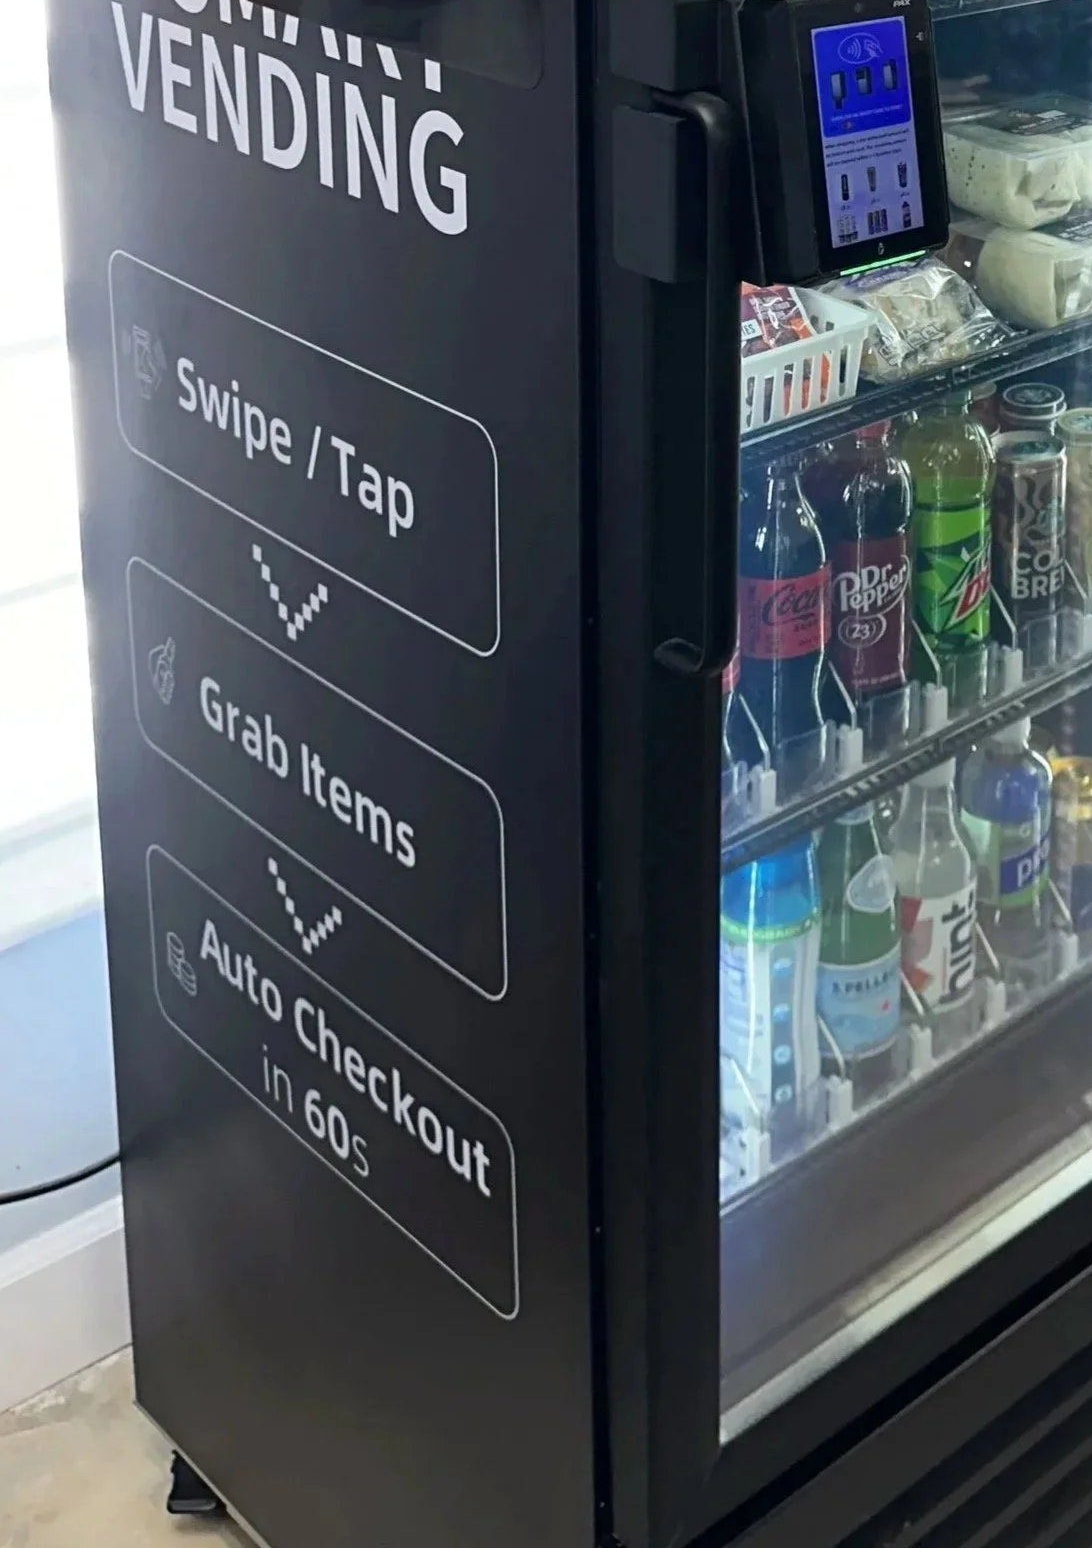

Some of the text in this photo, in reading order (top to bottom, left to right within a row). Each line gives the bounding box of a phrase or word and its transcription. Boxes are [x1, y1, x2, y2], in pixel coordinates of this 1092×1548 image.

[111, 1, 468, 236] VENDING
[177, 355, 294, 468] Swipe
[330, 437, 416, 535] Tap
[840, 564, 907, 613] Pepper
[851, 623, 870, 640] 23
[861, 564, 892, 590] Dr
[200, 675, 417, 868] Grab Items
[939, 903, 973, 1005] hint
[200, 915, 491, 1198] Auto Checkout
[261, 1044, 371, 1179] in 60s
